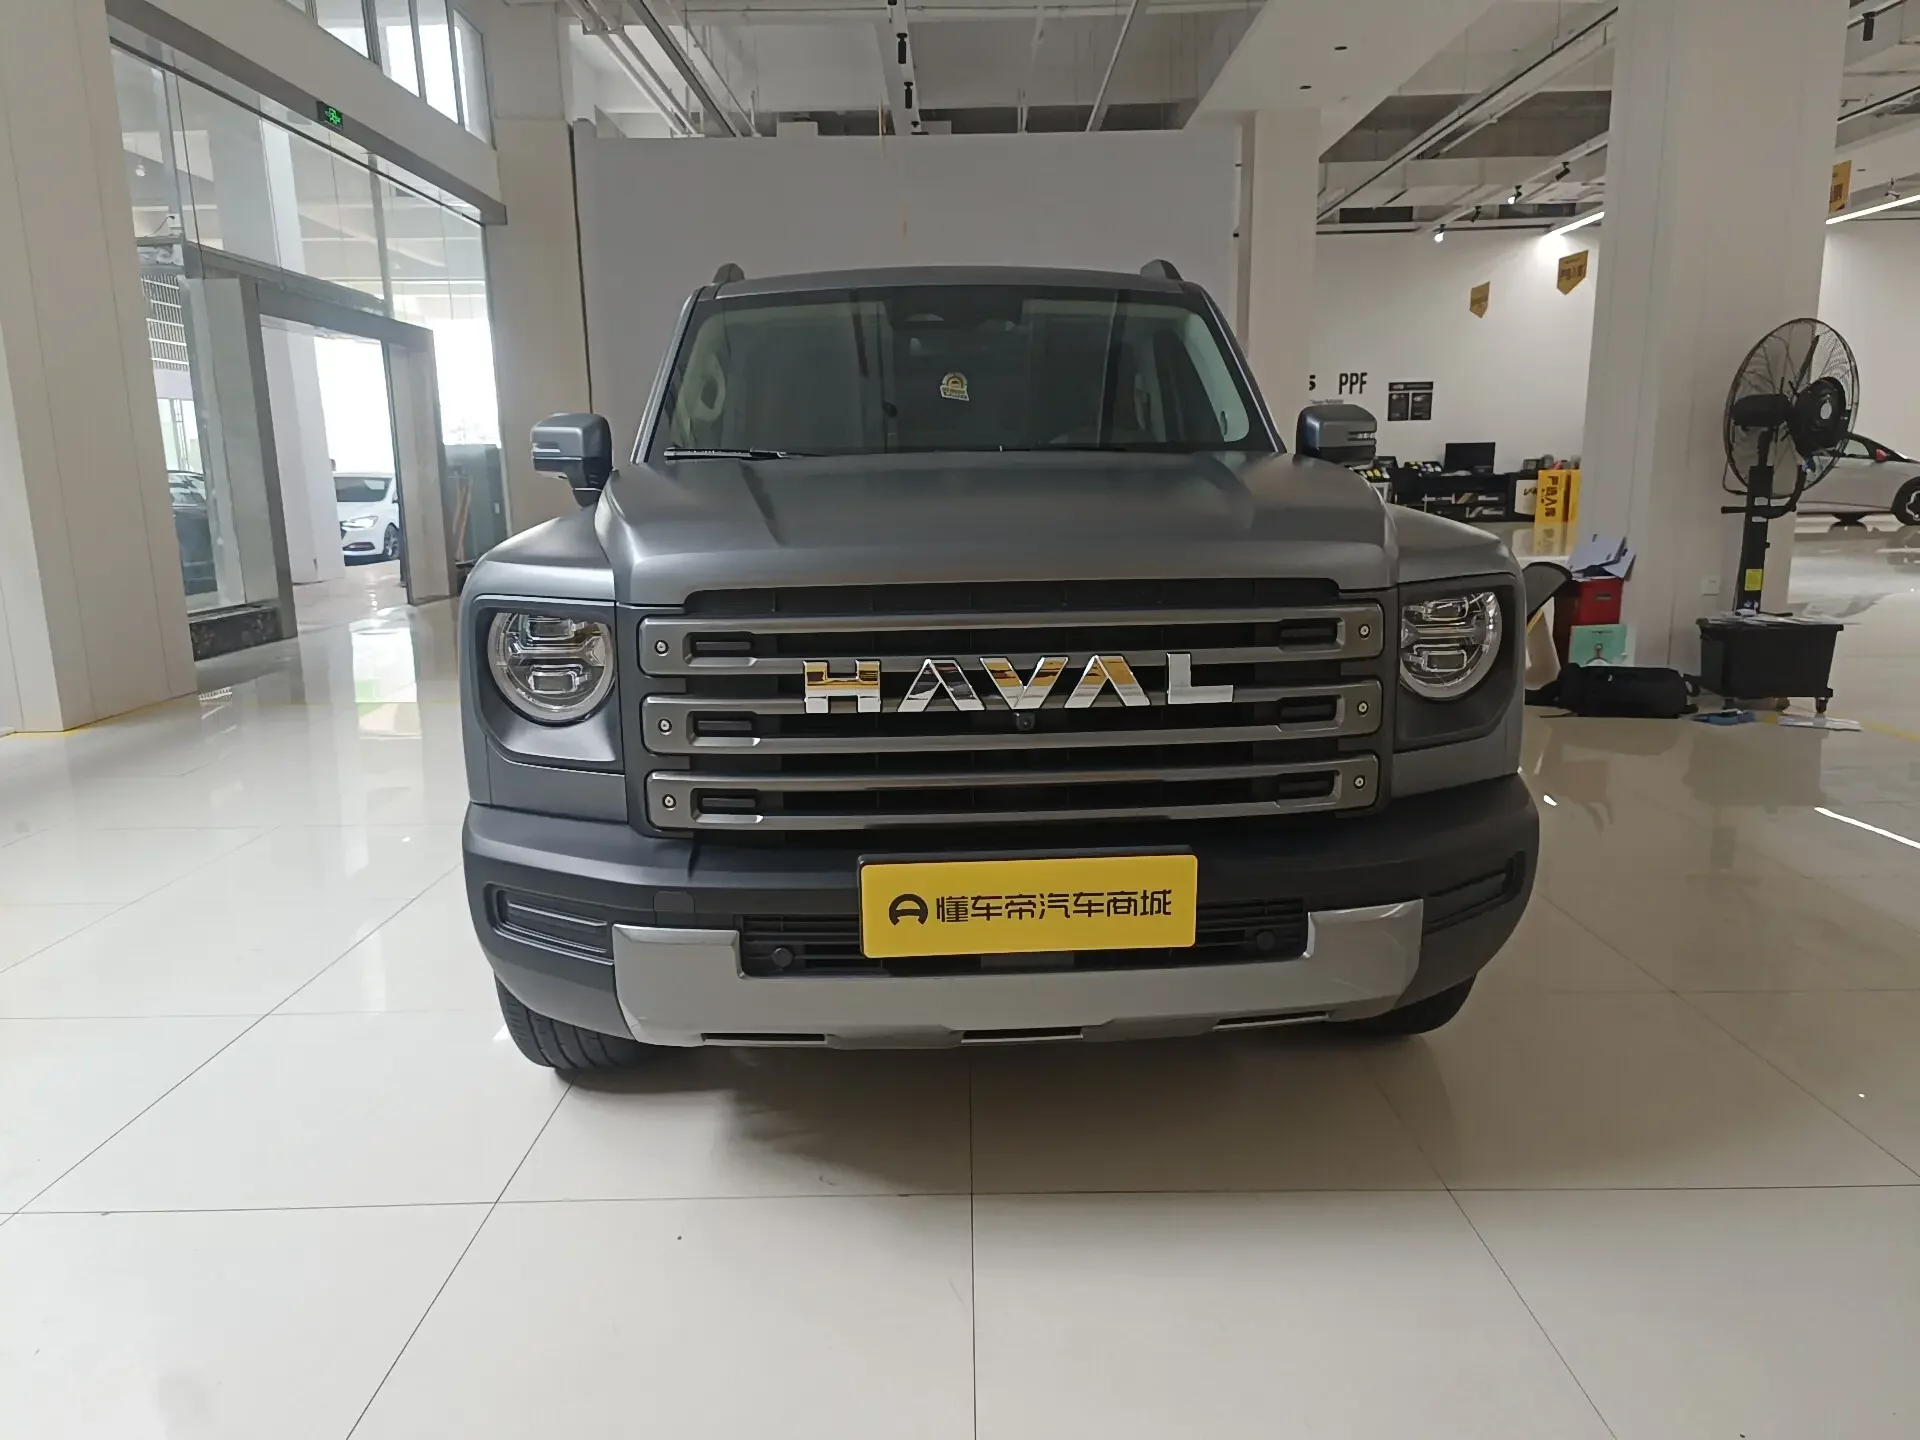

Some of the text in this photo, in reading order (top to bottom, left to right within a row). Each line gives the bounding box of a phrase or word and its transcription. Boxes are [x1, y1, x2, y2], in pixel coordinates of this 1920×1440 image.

[1338, 372, 1368, 395] PPF
[803, 652, 1234, 712] HAVAL
[935, 888, 1172, 923] 懂车帝汽车商城
